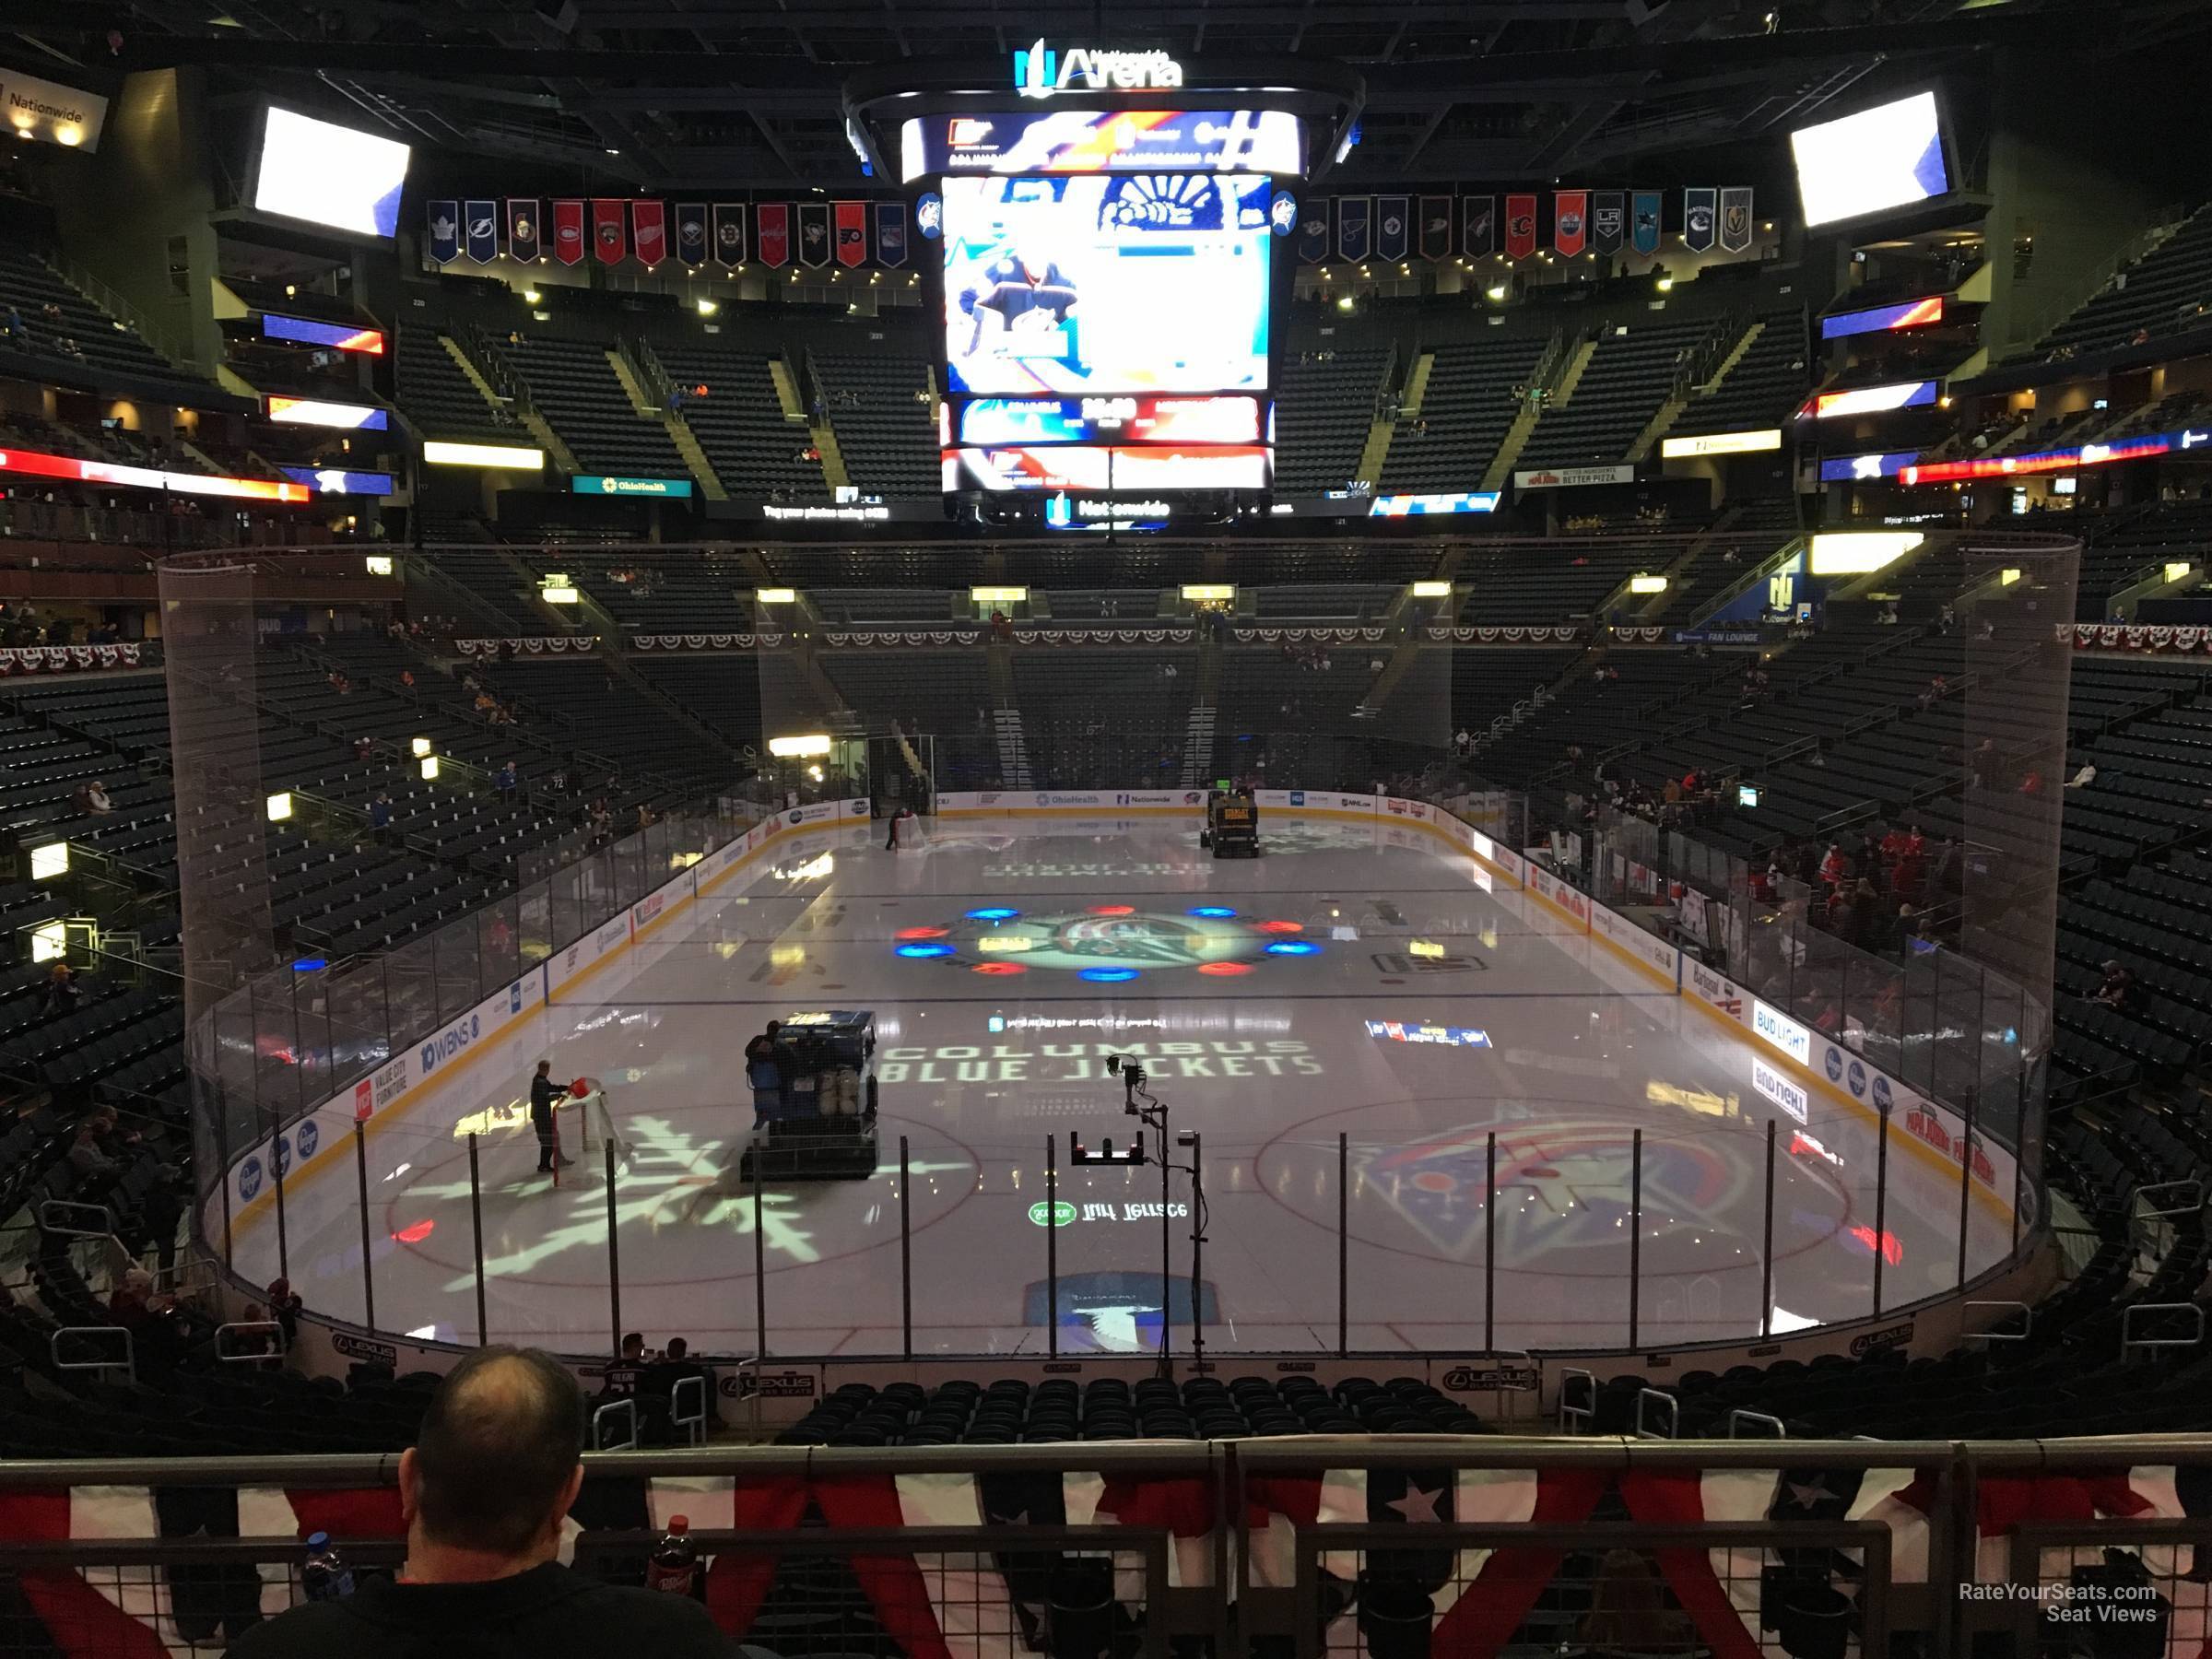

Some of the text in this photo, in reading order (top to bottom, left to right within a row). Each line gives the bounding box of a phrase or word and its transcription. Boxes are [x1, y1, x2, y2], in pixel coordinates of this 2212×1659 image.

[1056, 49, 1182, 88] Arena
[9, 92, 83, 124] Nationwide
[618, 481, 666, 492] OhioHealth
[1562, 475, 1592, 484] BETTER
[1079, 500, 1171, 516] Natonwide
[1709, 632, 1724, 641] FAN
[1725, 632, 1759, 642] LOUNGE
[1052, 795, 1099, 804] OhioHealth
[1758, 1010, 1806, 1053] BUD LIGHT
[882, 1041, 1311, 1060] COLUMBUS
[375, 1059, 406, 1089] VALUE CITY
[877, 1058, 1029, 1083] BLUE
[376, 1075, 407, 1107] FURNITURE
[1869, 1326, 1912, 1344] LEXUS
[348, 1339, 394, 1359] LEXUS
[747, 1377, 812, 1388] LEXUS
[1469, 1371, 1535, 1383] LEXUS
